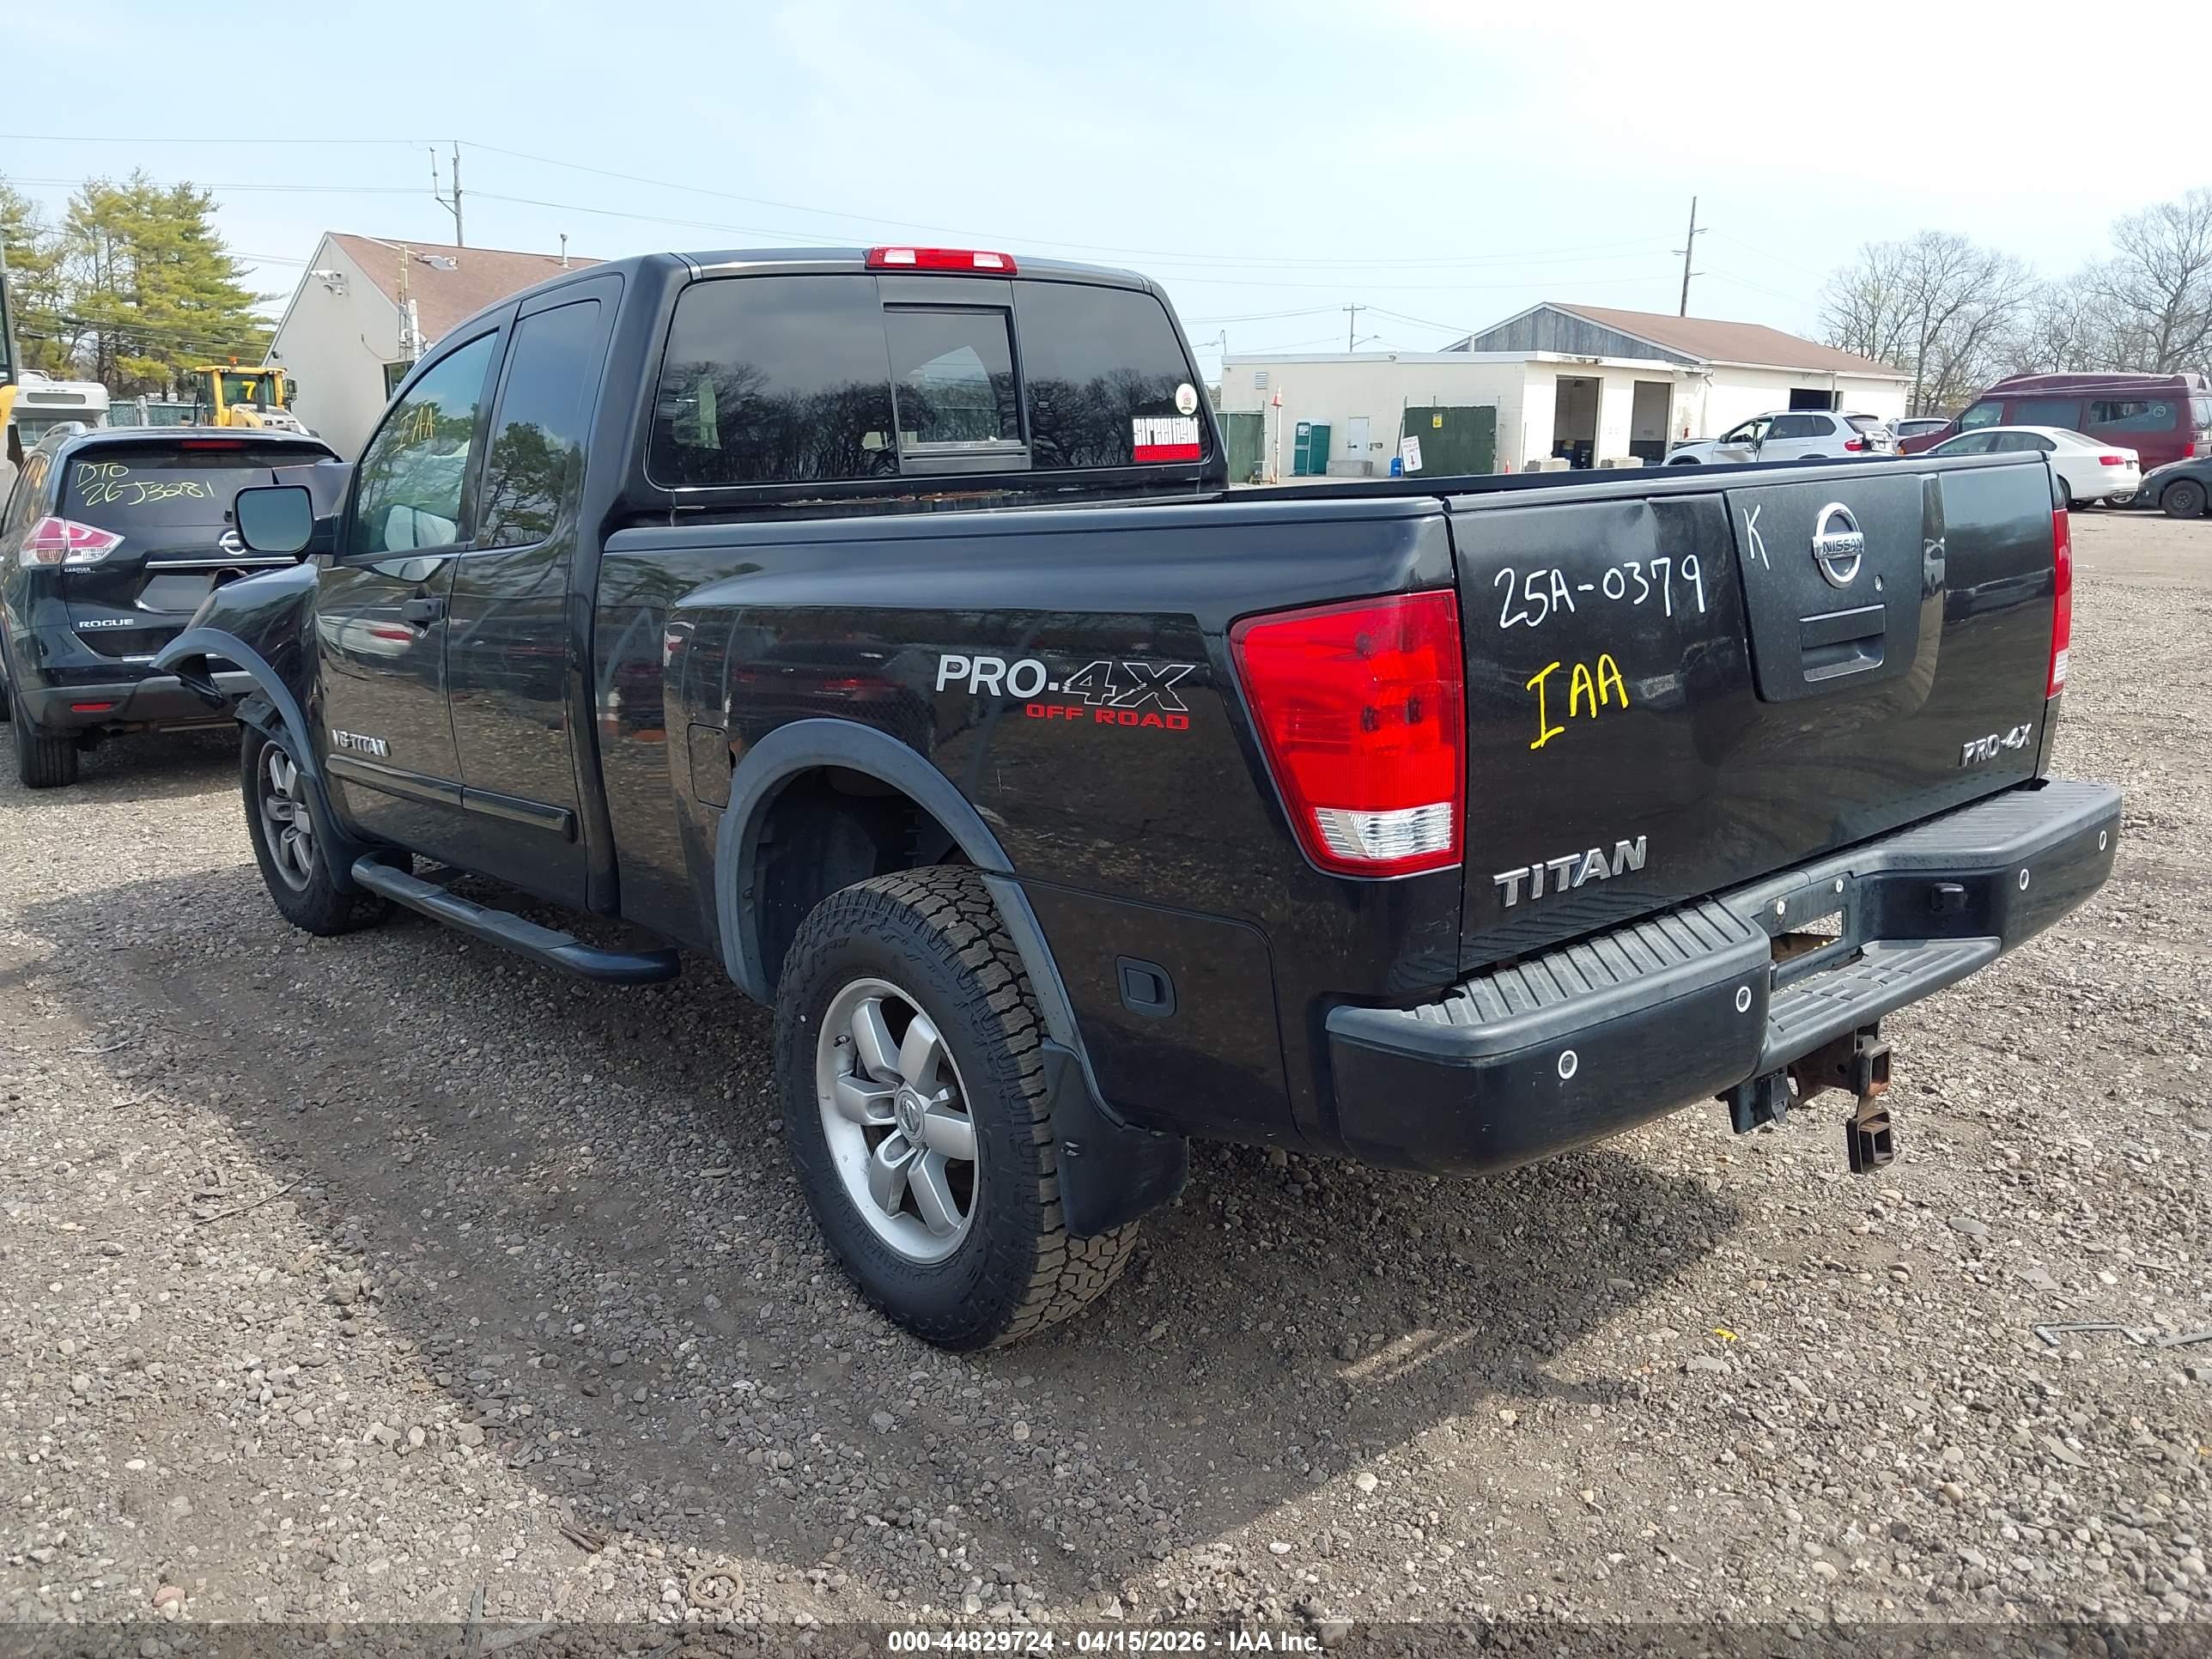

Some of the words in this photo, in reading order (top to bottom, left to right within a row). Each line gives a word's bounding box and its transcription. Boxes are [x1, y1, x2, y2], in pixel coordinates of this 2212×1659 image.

[242, 380, 257, 400] 7
[391, 406, 436, 454] IAA
[76, 462, 130, 489] DTO
[82, 480, 216, 507] 26J3281
[1742, 504, 1771, 571] K
[1822, 538, 1864, 555] NISSAN
[1493, 554, 1706, 629] 25A-0379
[79, 618, 135, 629] ROGUE
[935, 654, 1198, 712] PRO-4X
[1526, 653, 1629, 750] IAA
[1026, 703, 1084, 720] OFF
[1095, 708, 1189, 730] ROAD
[1960, 723, 2033, 768] PRO-4X
[1492, 835, 1647, 908] TITAN
